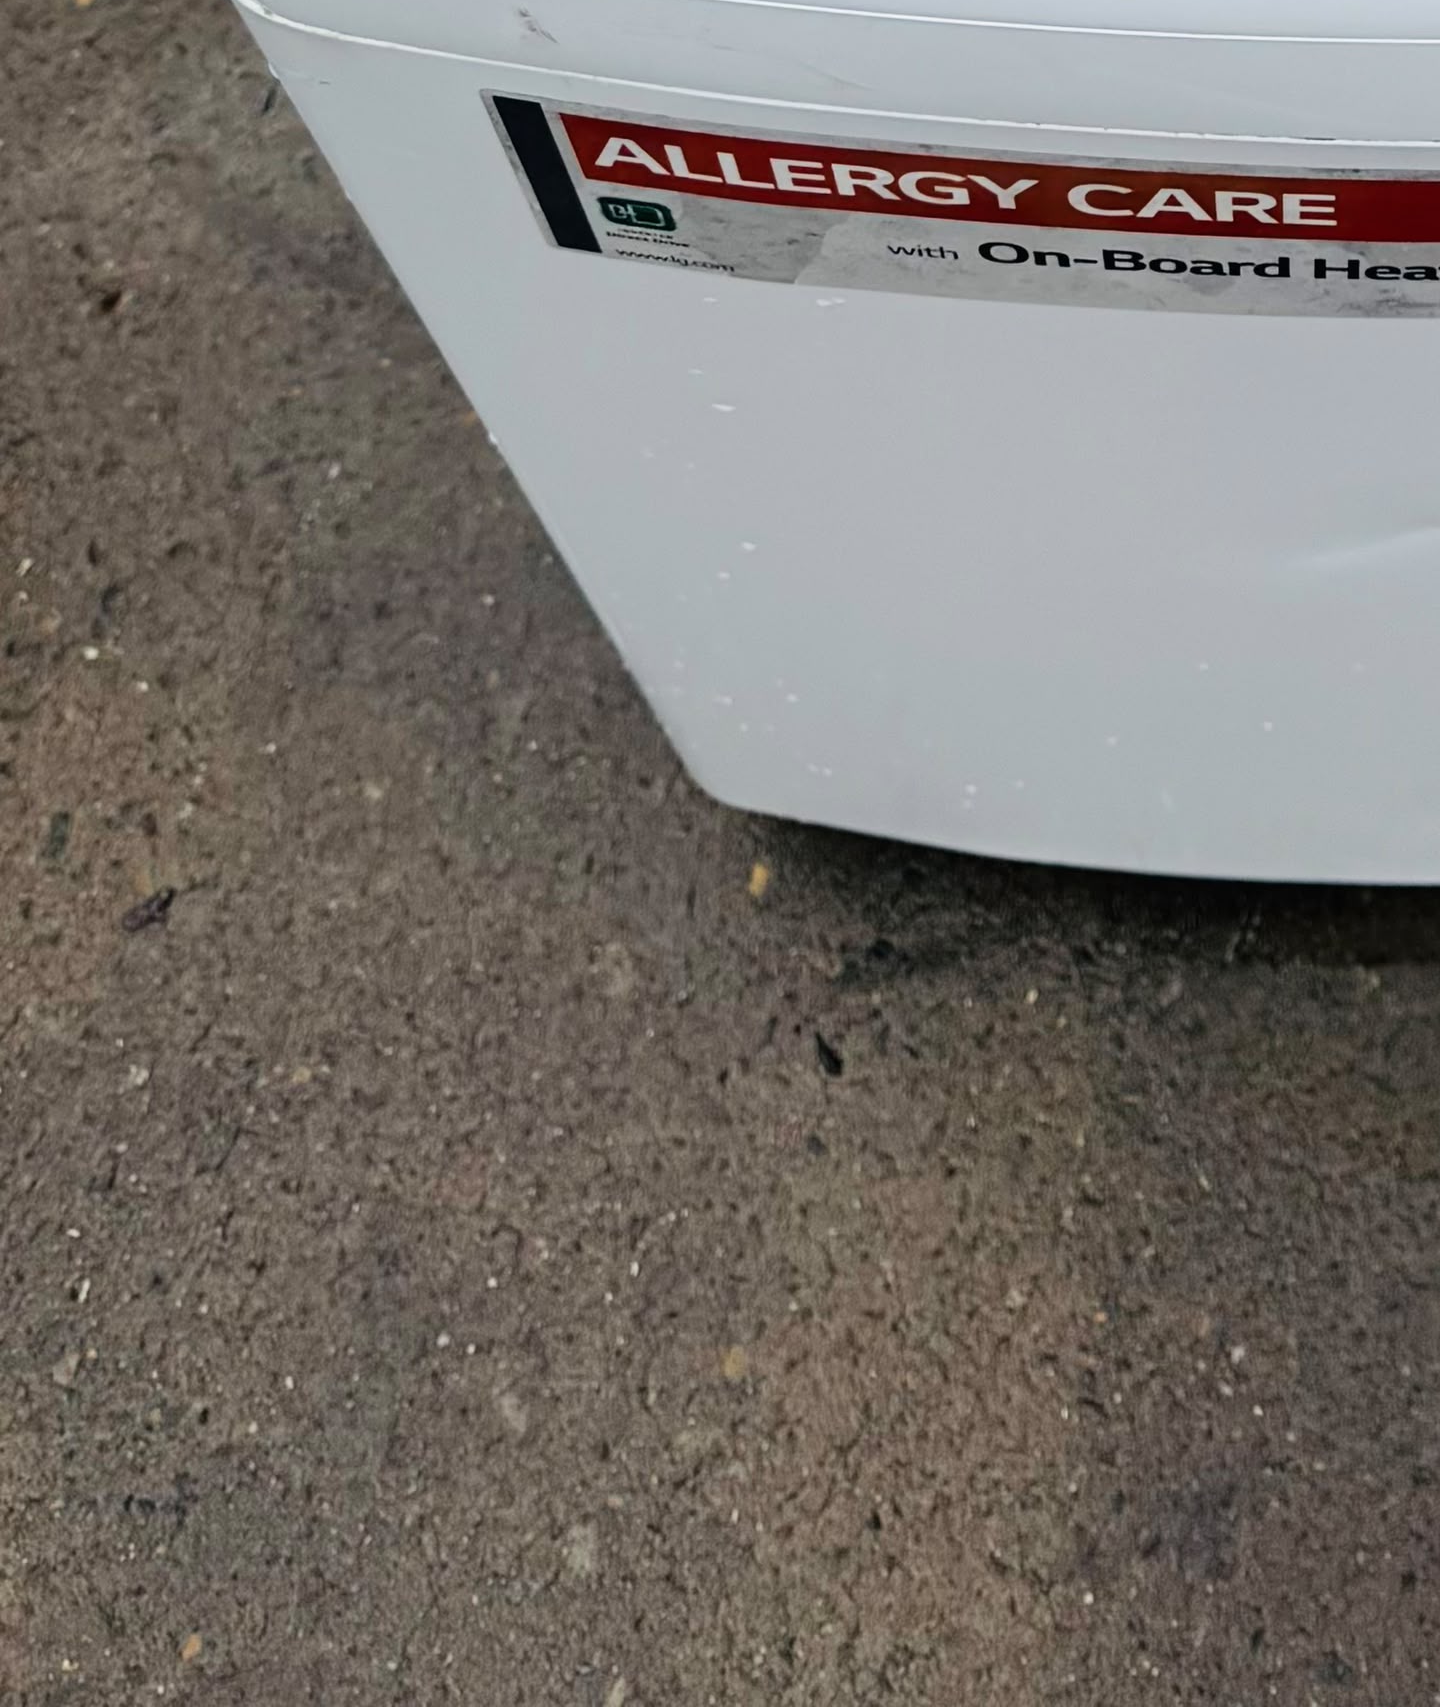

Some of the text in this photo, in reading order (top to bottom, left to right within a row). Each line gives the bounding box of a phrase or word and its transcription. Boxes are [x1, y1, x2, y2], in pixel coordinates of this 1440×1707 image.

[594, 136, 1338, 227] ALLERGY CARE
[887, 243, 960, 261] with
[977, 241, 1291, 280] On-Board
